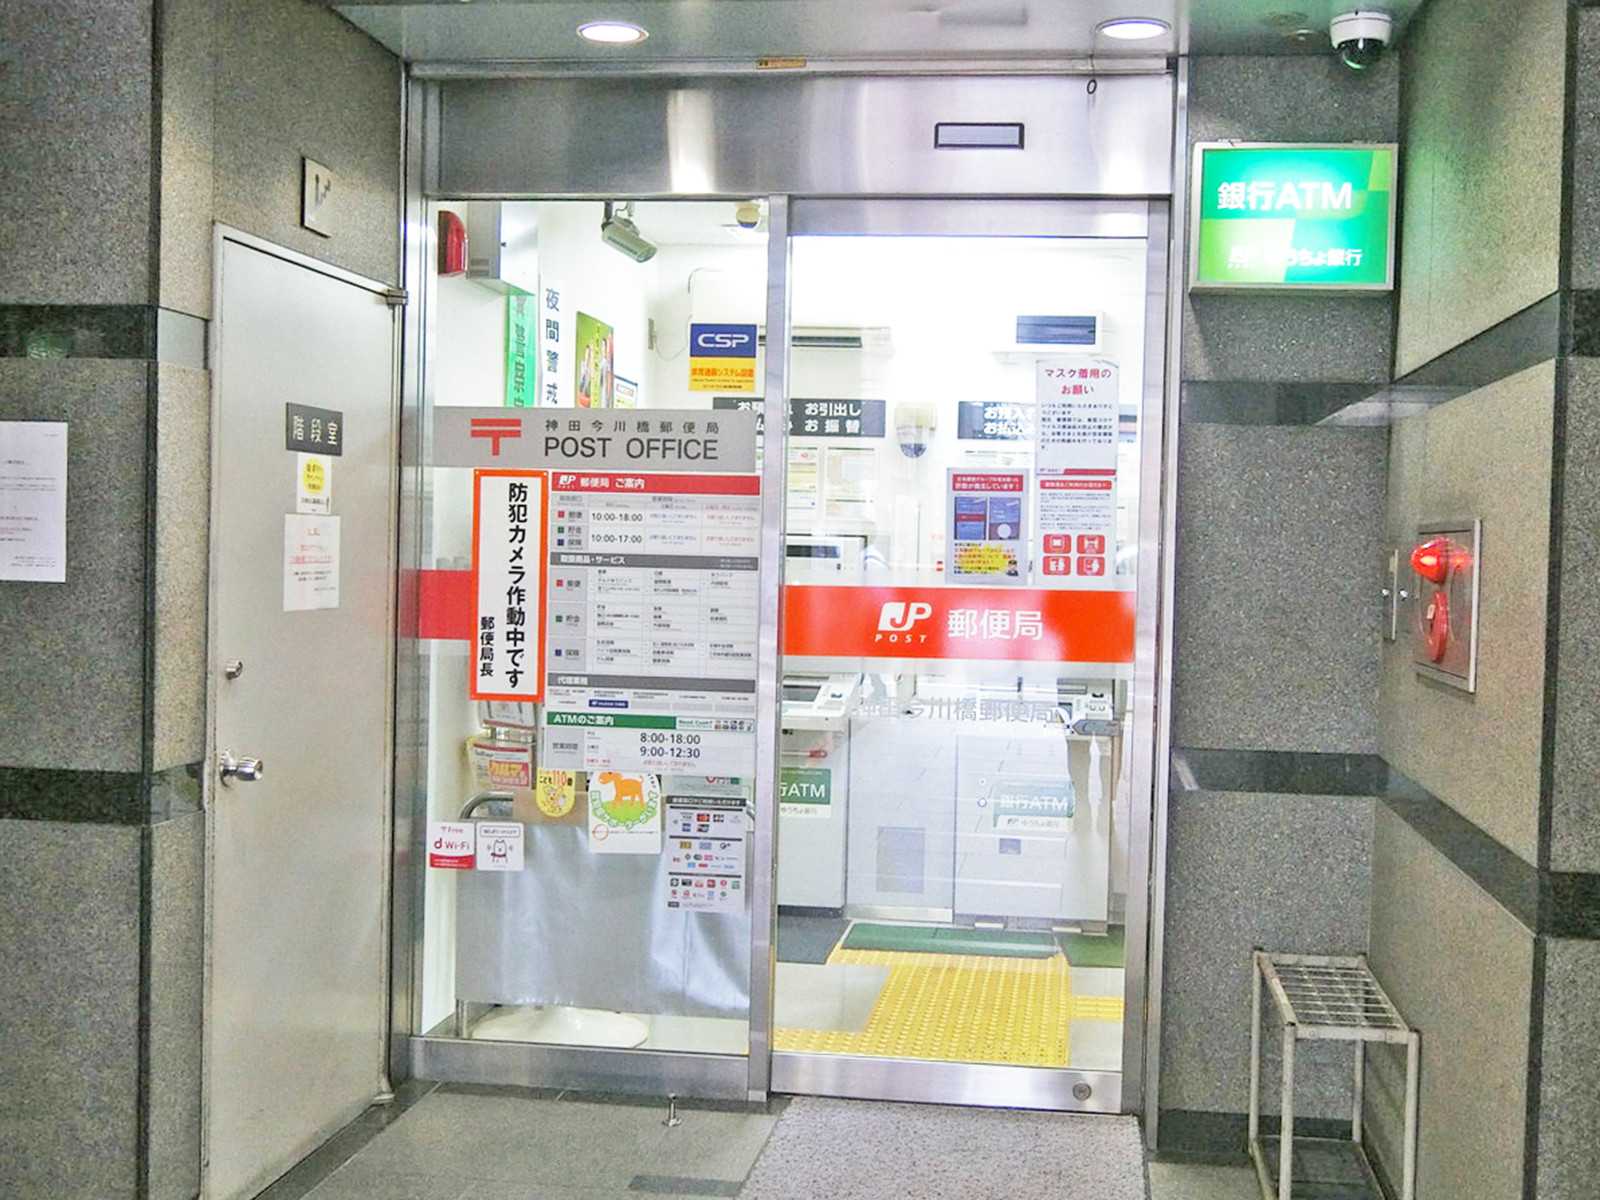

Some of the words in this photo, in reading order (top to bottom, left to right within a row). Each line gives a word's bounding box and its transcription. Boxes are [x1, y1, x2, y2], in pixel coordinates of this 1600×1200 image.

[1217, 182, 1352, 210] 銀行ATM
[698, 333, 749, 348] CSP
[1045, 368, 1112, 379] マスク着用の
[1061, 384, 1095, 395] お願い
[804, 402, 862, 417] お引出し
[293, 415, 338, 445] 階段室
[545, 419, 719, 435] 神田今川橋郵便局
[544, 437, 612, 457] POST
[626, 438, 719, 460] OFFICE
[615, 478, 645, 489] ご案内
[592, 512, 643, 521] 10:00-18:00
[591, 534, 643, 543] 10:00-17:00
[505, 482, 528, 688] 防犯カメラ作動中です
[877, 601, 933, 632] JP
[947, 608, 1044, 641] 郵便局
[874, 633, 927, 643] POST
[479, 616, 495, 677] 郵便局長
[553, 713, 615, 725] ATMのご案内
[640, 732, 701, 745] 8:00-18:00
[640, 746, 701, 759] 9:00-12:30
[434, 837, 442, 849] d
[445, 841, 470, 850] Wi-Fi
